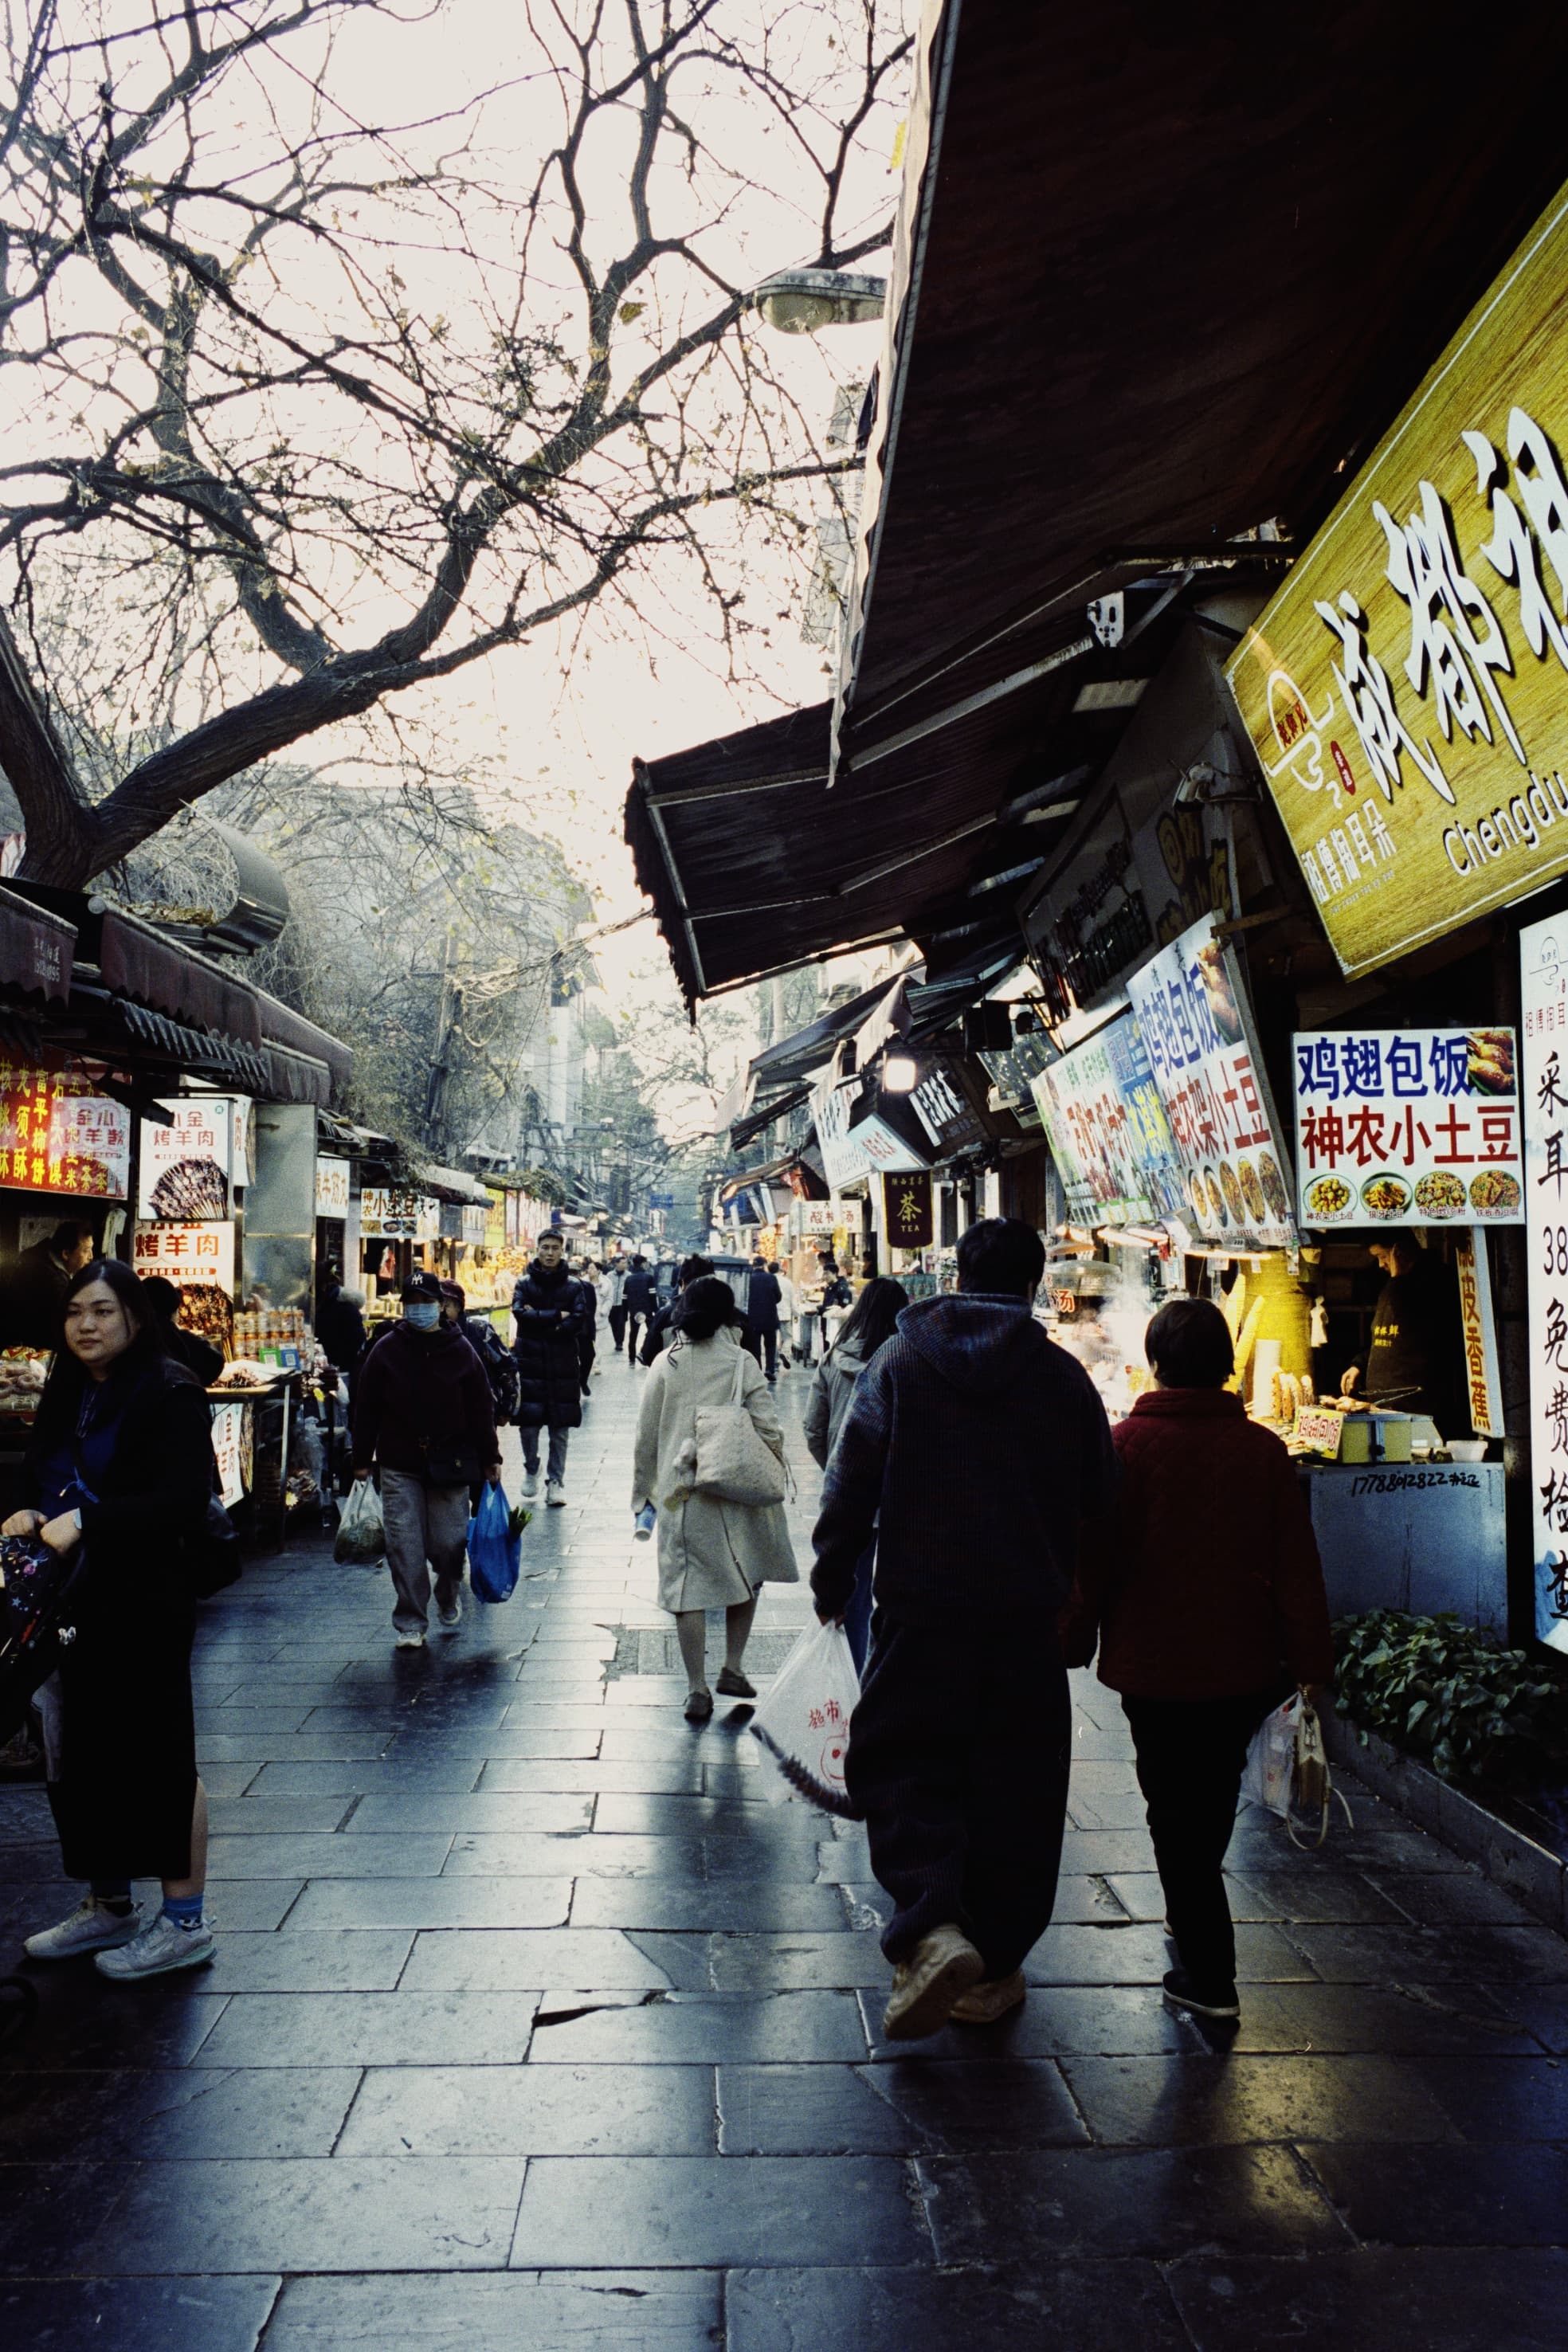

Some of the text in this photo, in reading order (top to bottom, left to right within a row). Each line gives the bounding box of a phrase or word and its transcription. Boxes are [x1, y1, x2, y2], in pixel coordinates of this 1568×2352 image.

[1139, 961, 1221, 1078] 鸡翅包饭
[1297, 1036, 1472, 1100] 鸡翅包饭
[154, 1130, 214, 1147] 烤羊肉
[1162, 1054, 1272, 1166] 神农架小土豆
[1299, 1103, 1518, 1170] 神农小土豆
[897, 1190, 923, 1222] 茶
[135, 1234, 218, 1257] 烤羊肉
[1543, 1225, 1568, 1276] 38
